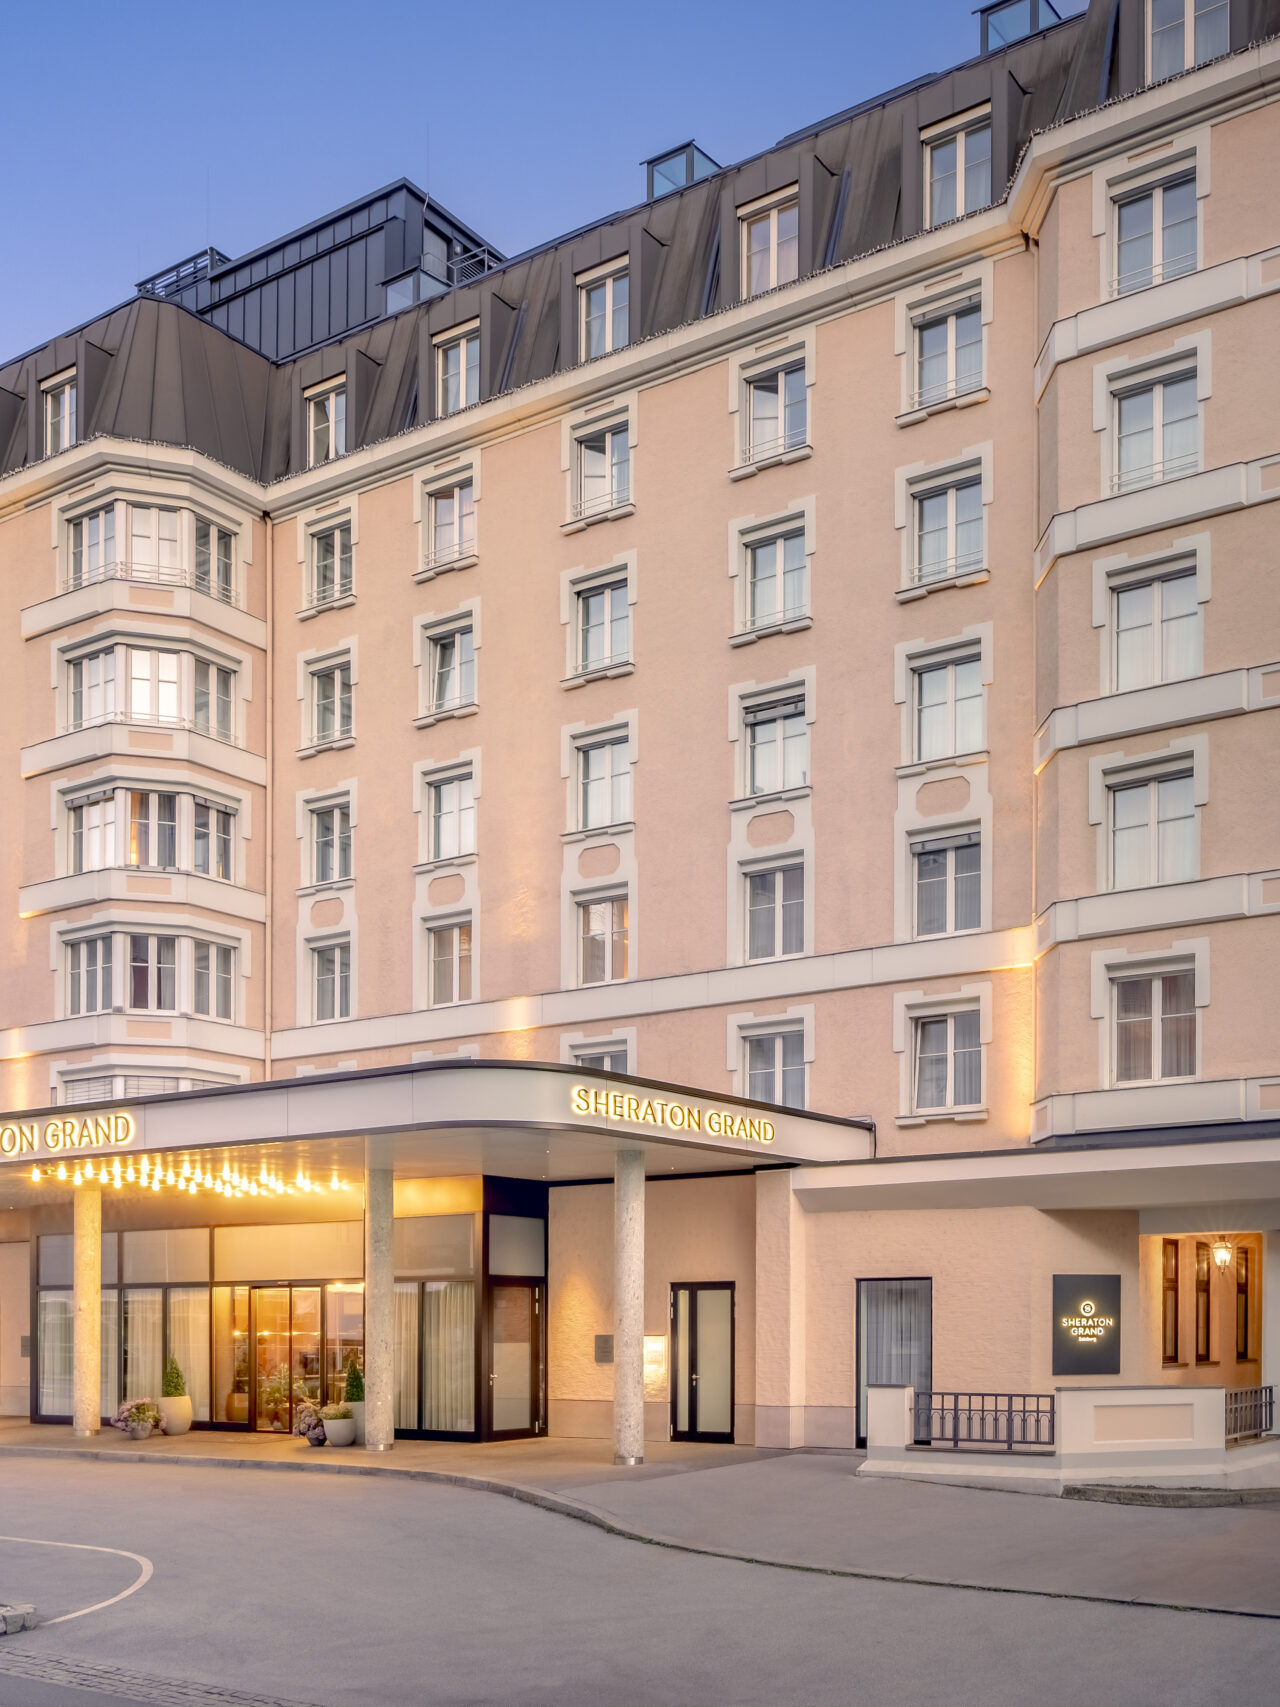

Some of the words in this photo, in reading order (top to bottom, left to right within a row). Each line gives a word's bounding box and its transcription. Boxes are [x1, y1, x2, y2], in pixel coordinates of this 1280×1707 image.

[574, 1087, 702, 1131] SHERATON
[707, 1111, 776, 1142] GRAND
[44, 1114, 135, 1150] GRAND
[1062, 1318, 1113, 1327] SHERATON
[1071, 1327, 1104, 1336] GRAND
